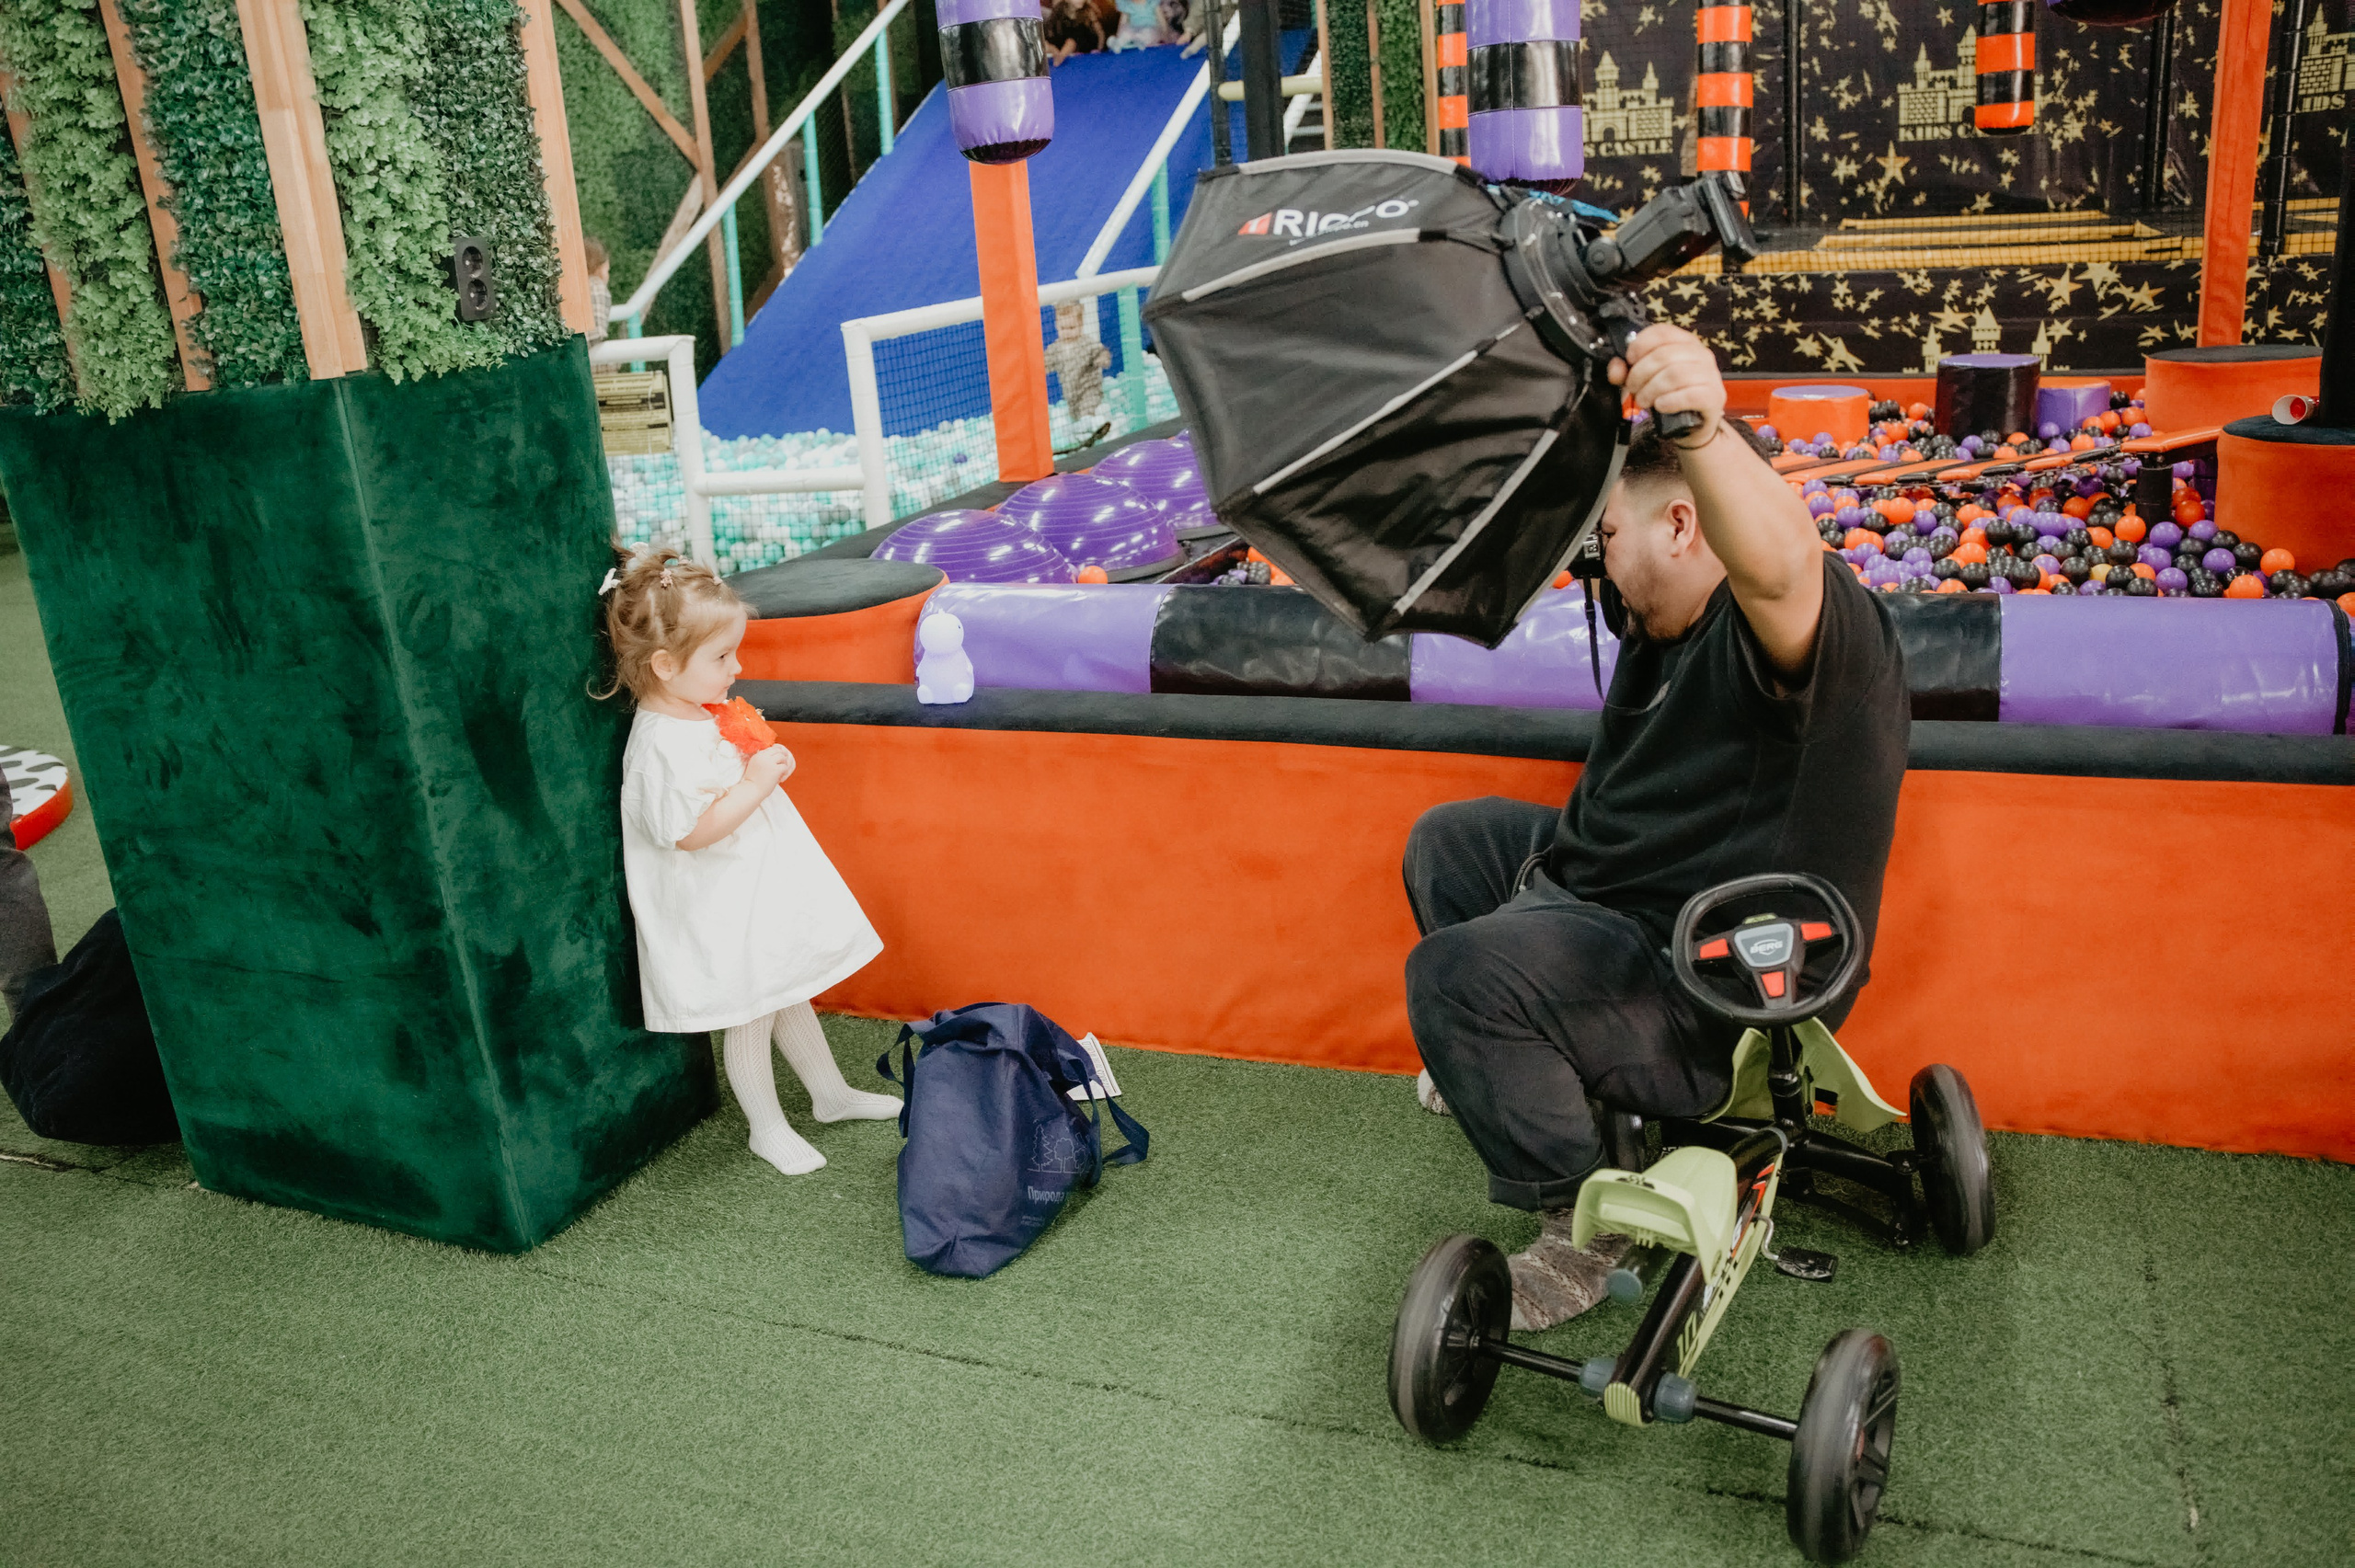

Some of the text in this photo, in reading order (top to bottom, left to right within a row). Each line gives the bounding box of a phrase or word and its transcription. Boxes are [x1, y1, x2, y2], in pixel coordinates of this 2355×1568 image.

[2295, 93, 2346, 114] IDS
[1899, 124, 1952, 142] KIDS
[1599, 138, 1673, 157] CASTLE
[1750, 940, 1783, 955] BERG
